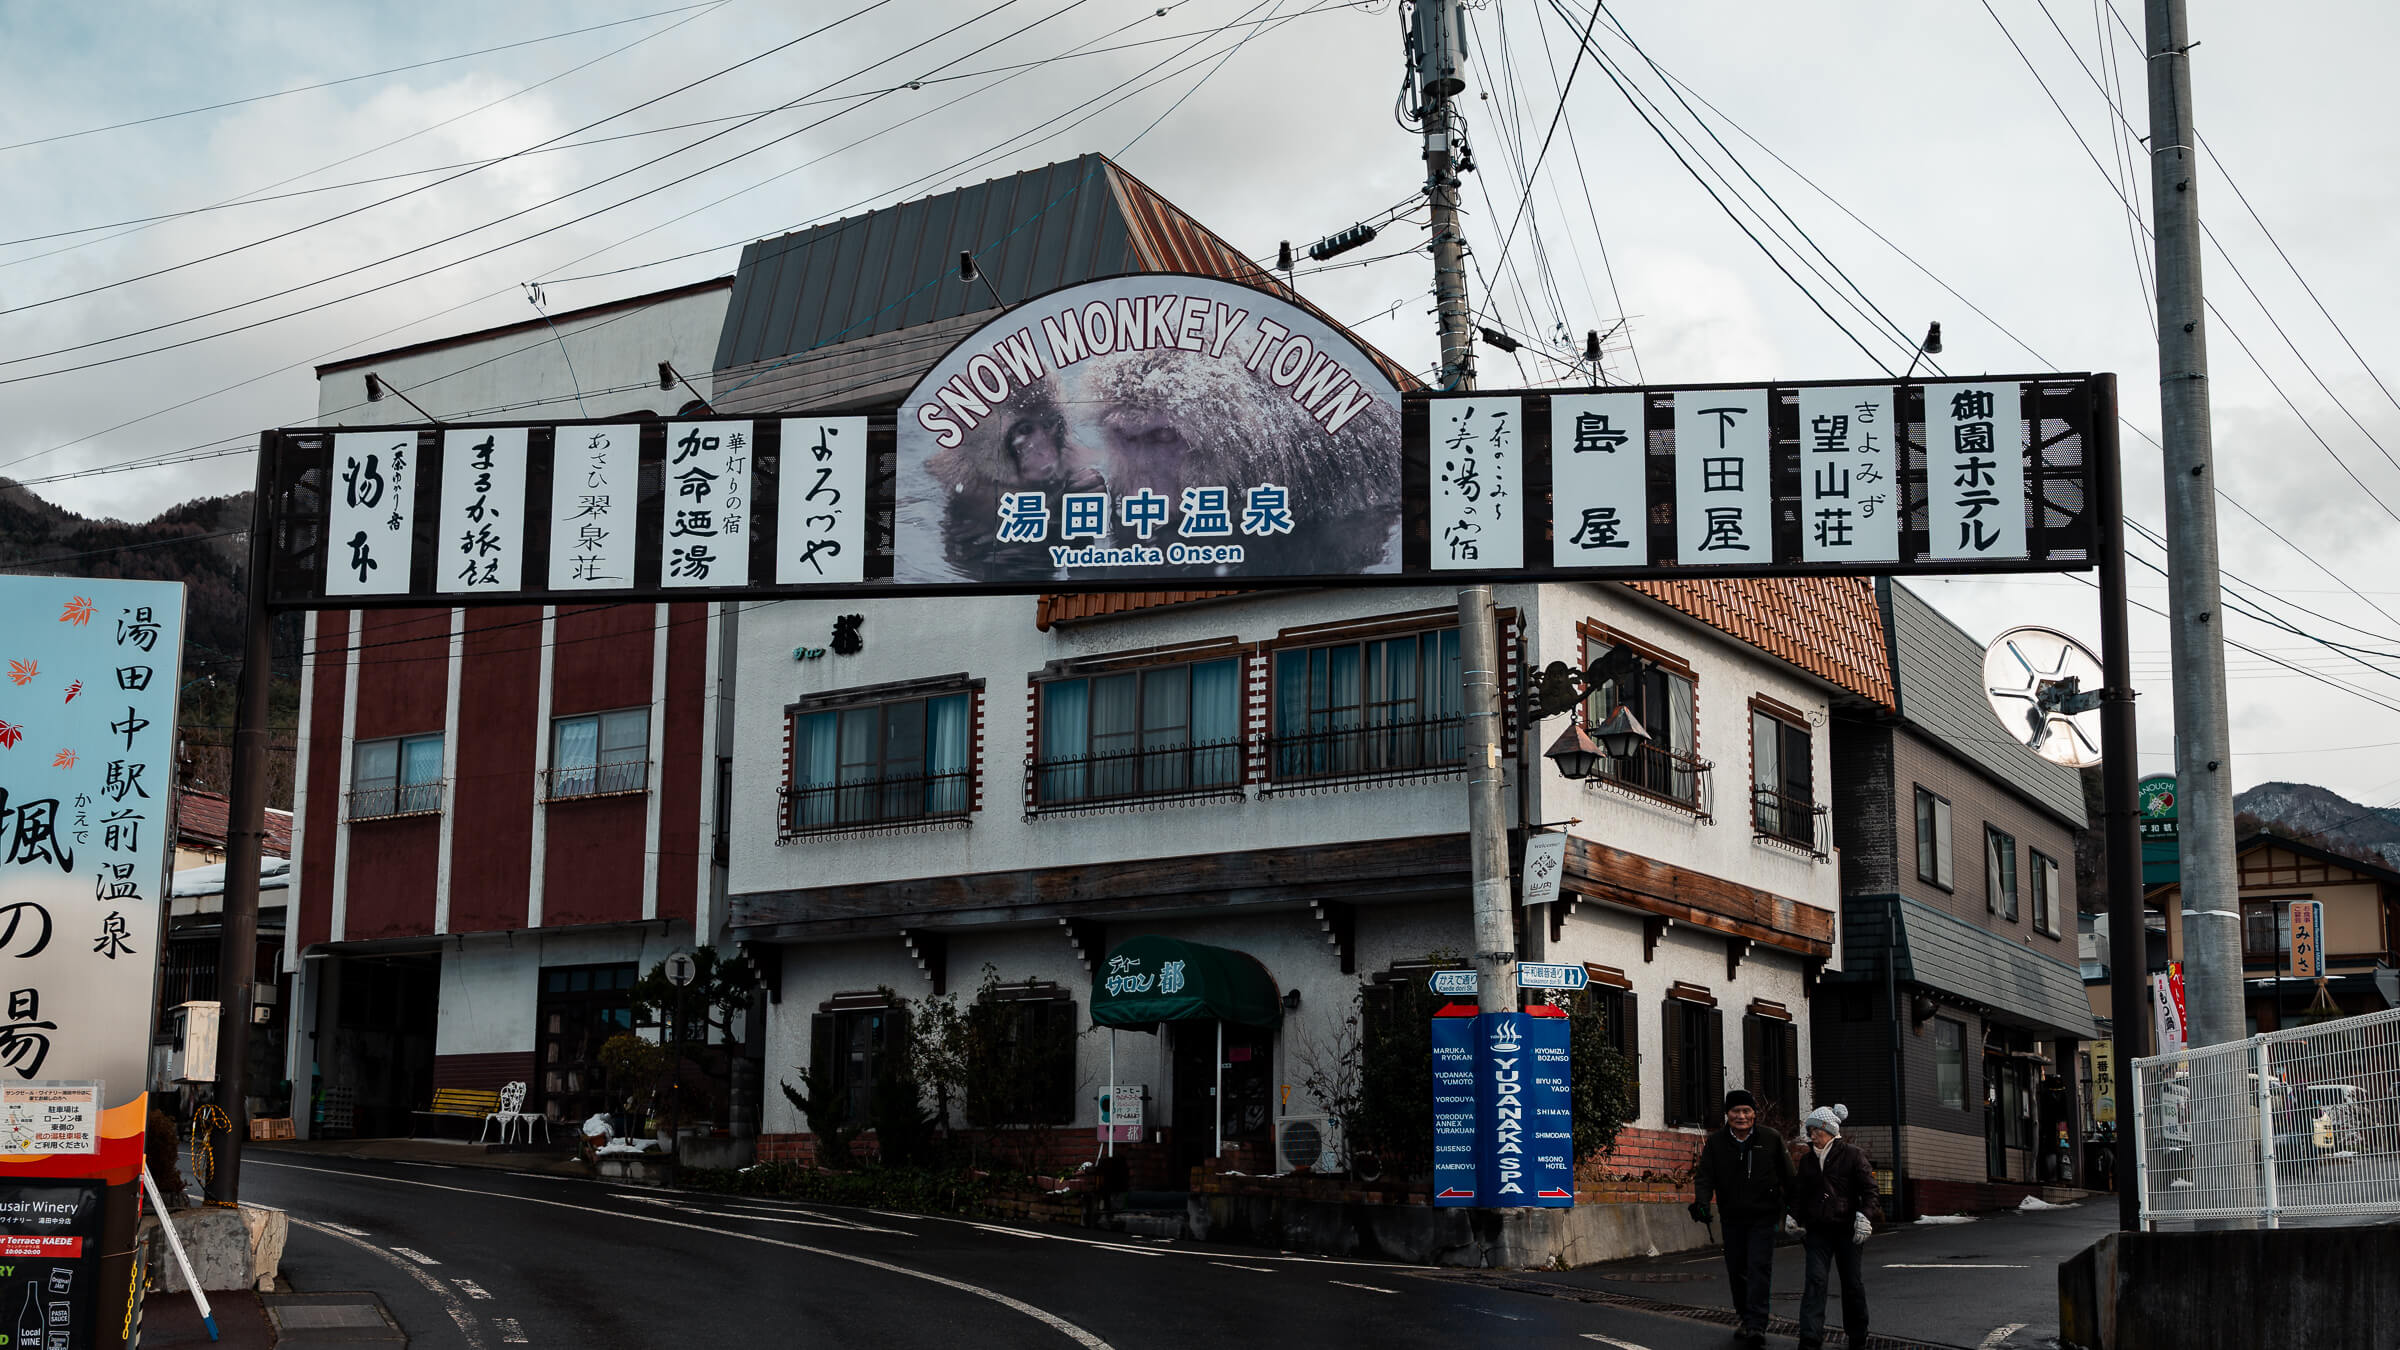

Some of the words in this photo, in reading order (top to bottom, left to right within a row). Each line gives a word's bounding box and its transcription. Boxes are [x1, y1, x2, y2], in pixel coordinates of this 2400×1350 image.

[917, 327, 1045, 449] SNOW
[1042, 294, 1249, 369] MONKEY
[1244, 317, 1373, 435] TOWN
[722, 433, 746, 534] 華灯りの宿
[1570, 411, 1629, 549] 島屋
[1697, 407, 1750, 551] 下田屋
[1811, 414, 1853, 547] 望山荘
[1854, 400, 1887, 518] きよみず
[1950, 389, 2001, 551] 御園ホテル
[800, 425, 843, 575] よろづや
[997, 483, 1296, 542] 湯田中温泉
[1049, 544, 1163, 567] Yudanaka
[1167, 543, 1245, 563] Onsen
[93, 606, 162, 960] 湯田中駅前温泉
[72, 792, 92, 845] かえで
[1109, 955, 1141, 974] ティー
[2295, 926, 2311, 972] みかさ
[1106, 973, 1154, 996] サロン
[1159, 960, 1186, 994] 都
[1439, 974, 1477, 985] かえで通り
[2097, 1055, 2108, 1095] 一番搾り
[1493, 1058, 1523, 1154] YUDANAKA
[1498, 1158, 1524, 1194] SPA
[33, 1201, 78, 1215] Winery
[42, 1238, 73, 1246] KAEDE
[20, 1338, 41, 1346] WINE
[21, 1328, 41, 1337] Local
